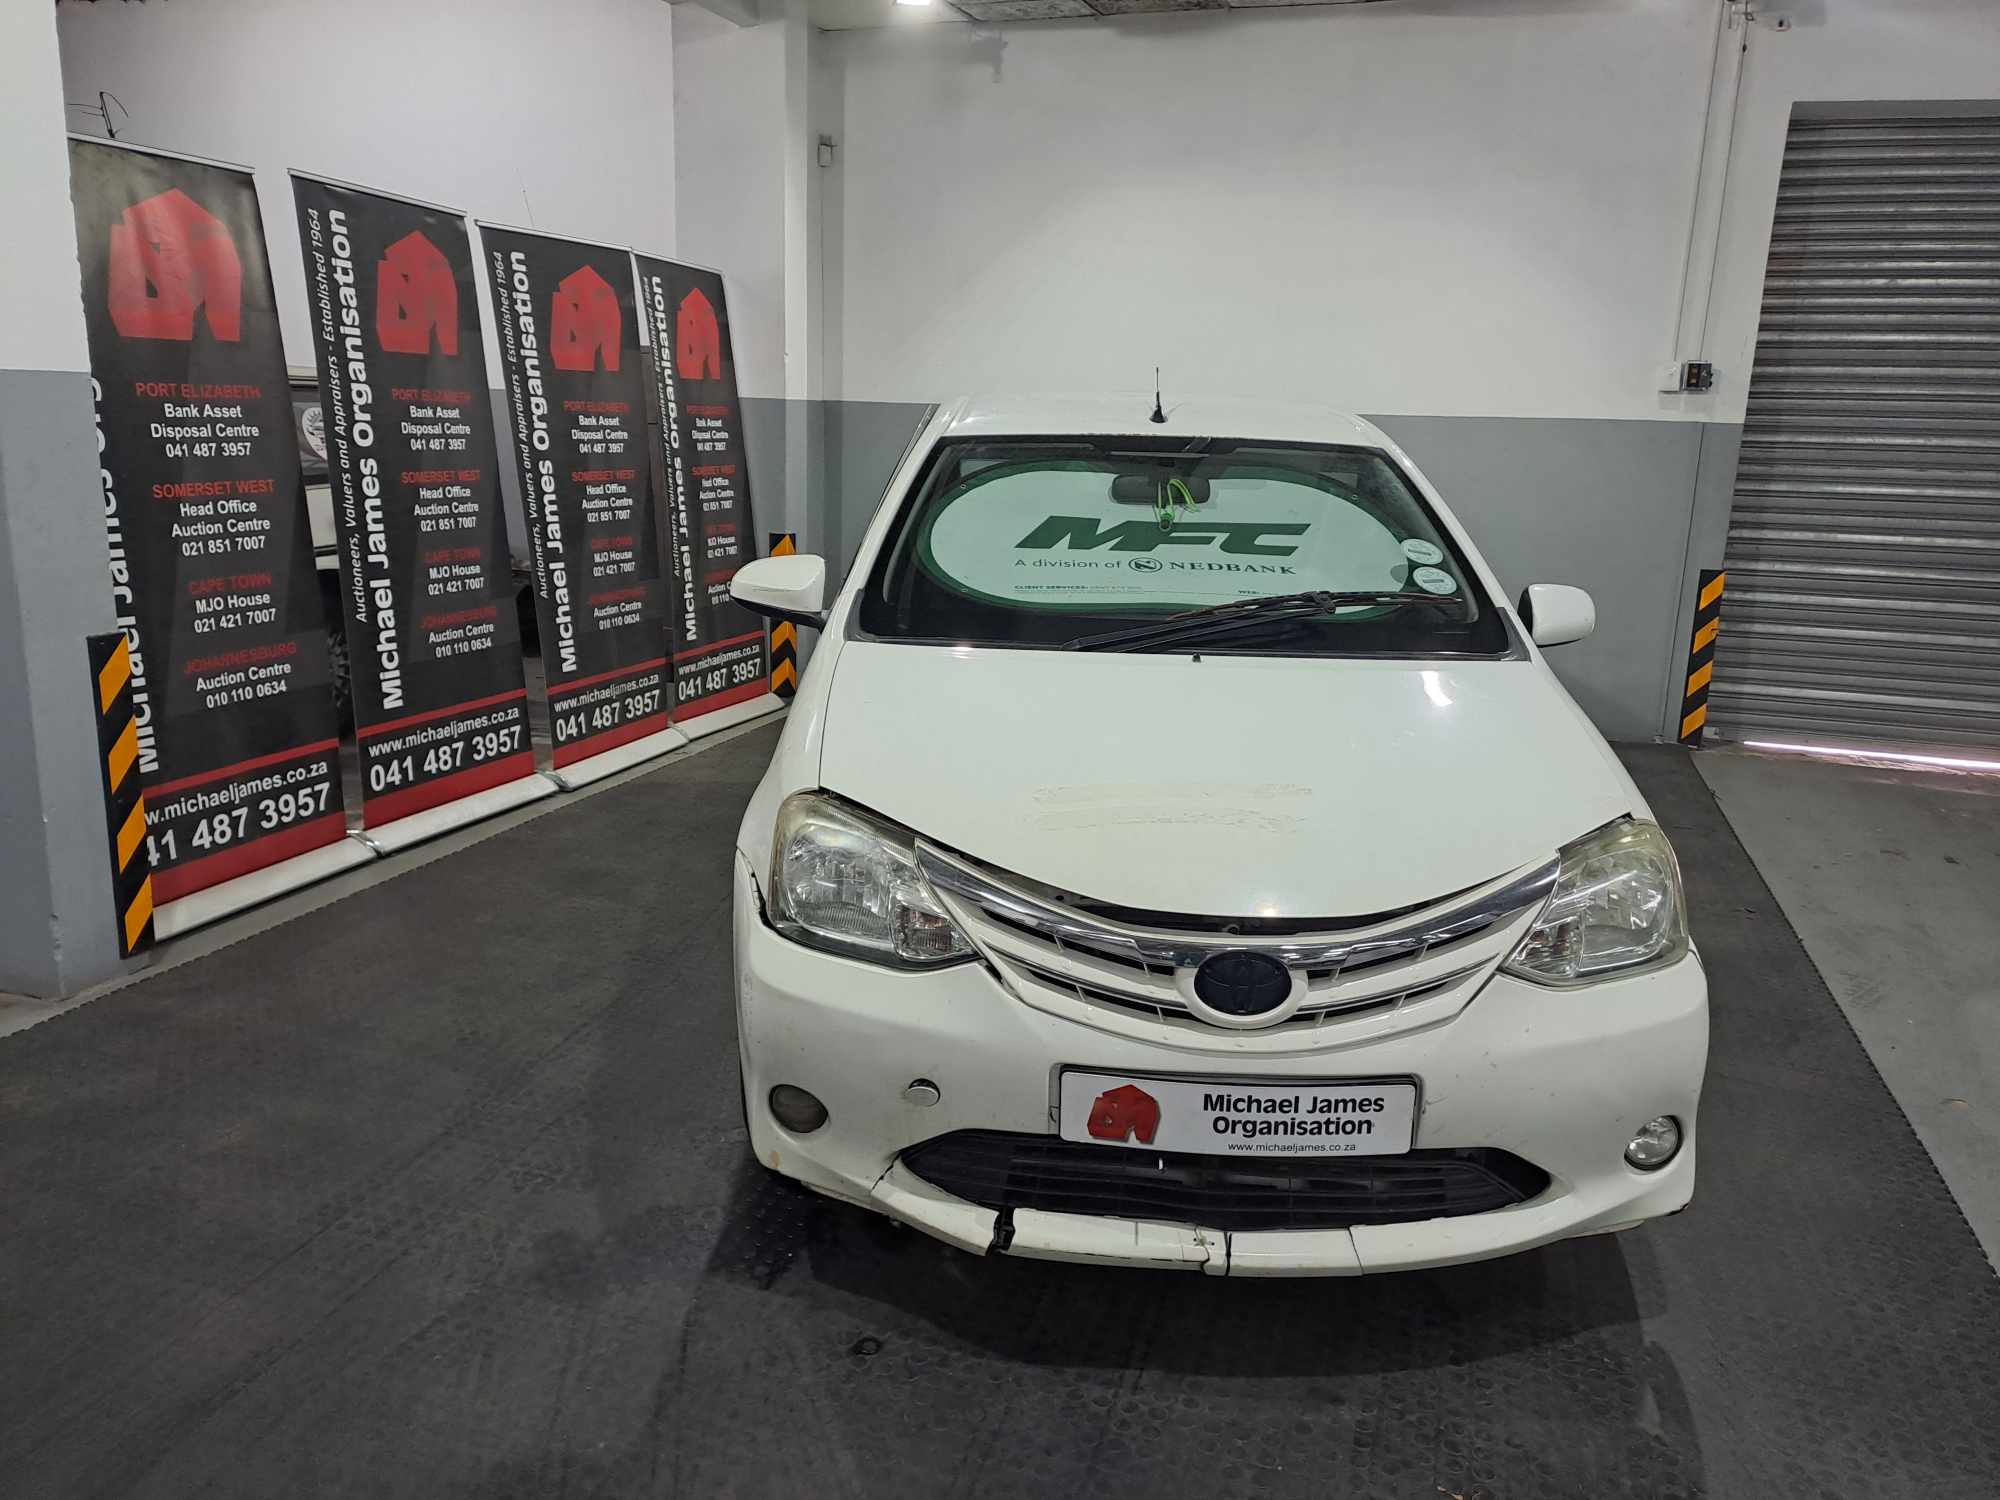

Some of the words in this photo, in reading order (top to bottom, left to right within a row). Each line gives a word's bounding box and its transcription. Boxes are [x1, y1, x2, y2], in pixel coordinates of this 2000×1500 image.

[307, 208, 322, 248] 1964
[312, 251, 335, 342] Established
[328, 209, 374, 447] Organisation
[499, 287, 517, 362] Established
[510, 251, 550, 450] Organisation
[652, 276, 679, 448] Organisation
[135, 382, 177, 397] PORT
[181, 384, 262, 398] ELIZABETH
[328, 356, 348, 436] Appraisers
[164, 403, 200, 418] Bank
[203, 404, 242, 418] Asset
[410, 405, 434, 419] Bank
[436, 406, 460, 419] Asset
[512, 374, 528, 441] Appraisers
[579, 415, 597, 425] Bank
[599, 416, 619, 425] Asset
[151, 424, 211, 440] Disposal
[215, 423, 260, 438] Centre
[401, 422, 442, 436] Disposal
[444, 422, 471, 435] Centre
[572, 429, 603, 441] Disposal
[605, 429, 628, 440] Centre
[166, 443, 189, 458] 041
[193, 443, 217, 457] 487
[221, 442, 251, 456] 3957
[336, 438, 351, 469] and
[410, 439, 426, 451] 041
[429, 439, 446, 450] 487
[448, 438, 466, 450] 3957
[519, 444, 531, 469] and
[152, 482, 232, 498] SOMERSET
[236, 479, 275, 493] WEST
[342, 473, 356, 528] Valuers
[419, 487, 443, 500] Head
[445, 486, 471, 498] Office
[525, 473, 538, 518] Valuers
[605, 484, 627, 494] Office
[674, 457, 688, 538] James
[180, 501, 214, 517] Head
[217, 499, 257, 514] Office
[359, 458, 389, 569] James
[414, 503, 449, 517] Auction
[452, 501, 479, 514] Centre
[538, 459, 563, 553] James
[582, 499, 608, 510] Auction
[610, 497, 633, 508] Centre
[171, 520, 223, 538] Auction
[227, 517, 271, 533] Centre
[420, 520, 436, 532] 021
[439, 518, 455, 530] 851
[458, 517, 476, 529] 7007
[1014, 515, 1311, 557] MFC
[182, 542, 204, 557] 021
[208, 539, 231, 554] 851
[235, 536, 266, 551] 7007
[610, 550, 632, 561] House
[429, 566, 449, 580] MJO
[452, 564, 481, 577] House
[532, 523, 549, 599] Auctioneers,
[1014, 559, 1027, 568] A
[1033, 558, 1099, 569] division
[1105, 560, 1122, 569] of
[1169, 561, 1297, 575] NEDBANK
[189, 577, 225, 595] CAPE
[232, 572, 272, 590] TOWN
[350, 533, 368, 623] Auctioneers,
[428, 583, 444, 596] 021
[446, 581, 462, 594] 421
[464, 577, 485, 590] 7007
[196, 597, 224, 614] MJO
[228, 592, 270, 609] House
[680, 545, 697, 640] Michael
[194, 617, 216, 634] 021
[220, 613, 243, 630] 421
[247, 608, 276, 625] 7007
[549, 562, 577, 673] Michael
[593, 606, 619, 618] Auction
[369, 578, 404, 710] Michael
[429, 628, 464, 644] Auction
[466, 622, 494, 637] Centre
[436, 645, 451, 658] 010
[453, 641, 469, 654] 110
[470, 636, 492, 651] 0634
[196, 670, 245, 692] Auction
[249, 662, 292, 681] Centre
[679, 676, 702, 701] 041
[706, 668, 727, 691] 487
[732, 658, 761, 683] 3957
[206, 692, 228, 709] 010
[231, 686, 253, 704] 110
[256, 680, 287, 699] 0634
[554, 674, 659, 713] www.michaeljames.co.za
[556, 711, 587, 742] 041
[592, 701, 621, 729] 487
[625, 689, 660, 718] 3957
[368, 706, 519, 757] www.michaeljames.co.za
[370, 756, 415, 792] 041
[424, 741, 465, 775] 487
[472, 725, 521, 761] 3957
[145, 760, 328, 826] w.michaeljames.co.za
[147, 829, 177, 867] 41
[192, 807, 249, 849] 487
[259, 782, 330, 829] 3957
[1203, 1093, 1299, 1114] Michael
[1306, 1096, 1385, 1114] James
[1212, 1116, 1373, 1138] Organisation
[1227, 1141, 1357, 1154] www.michaeljames.co.za
